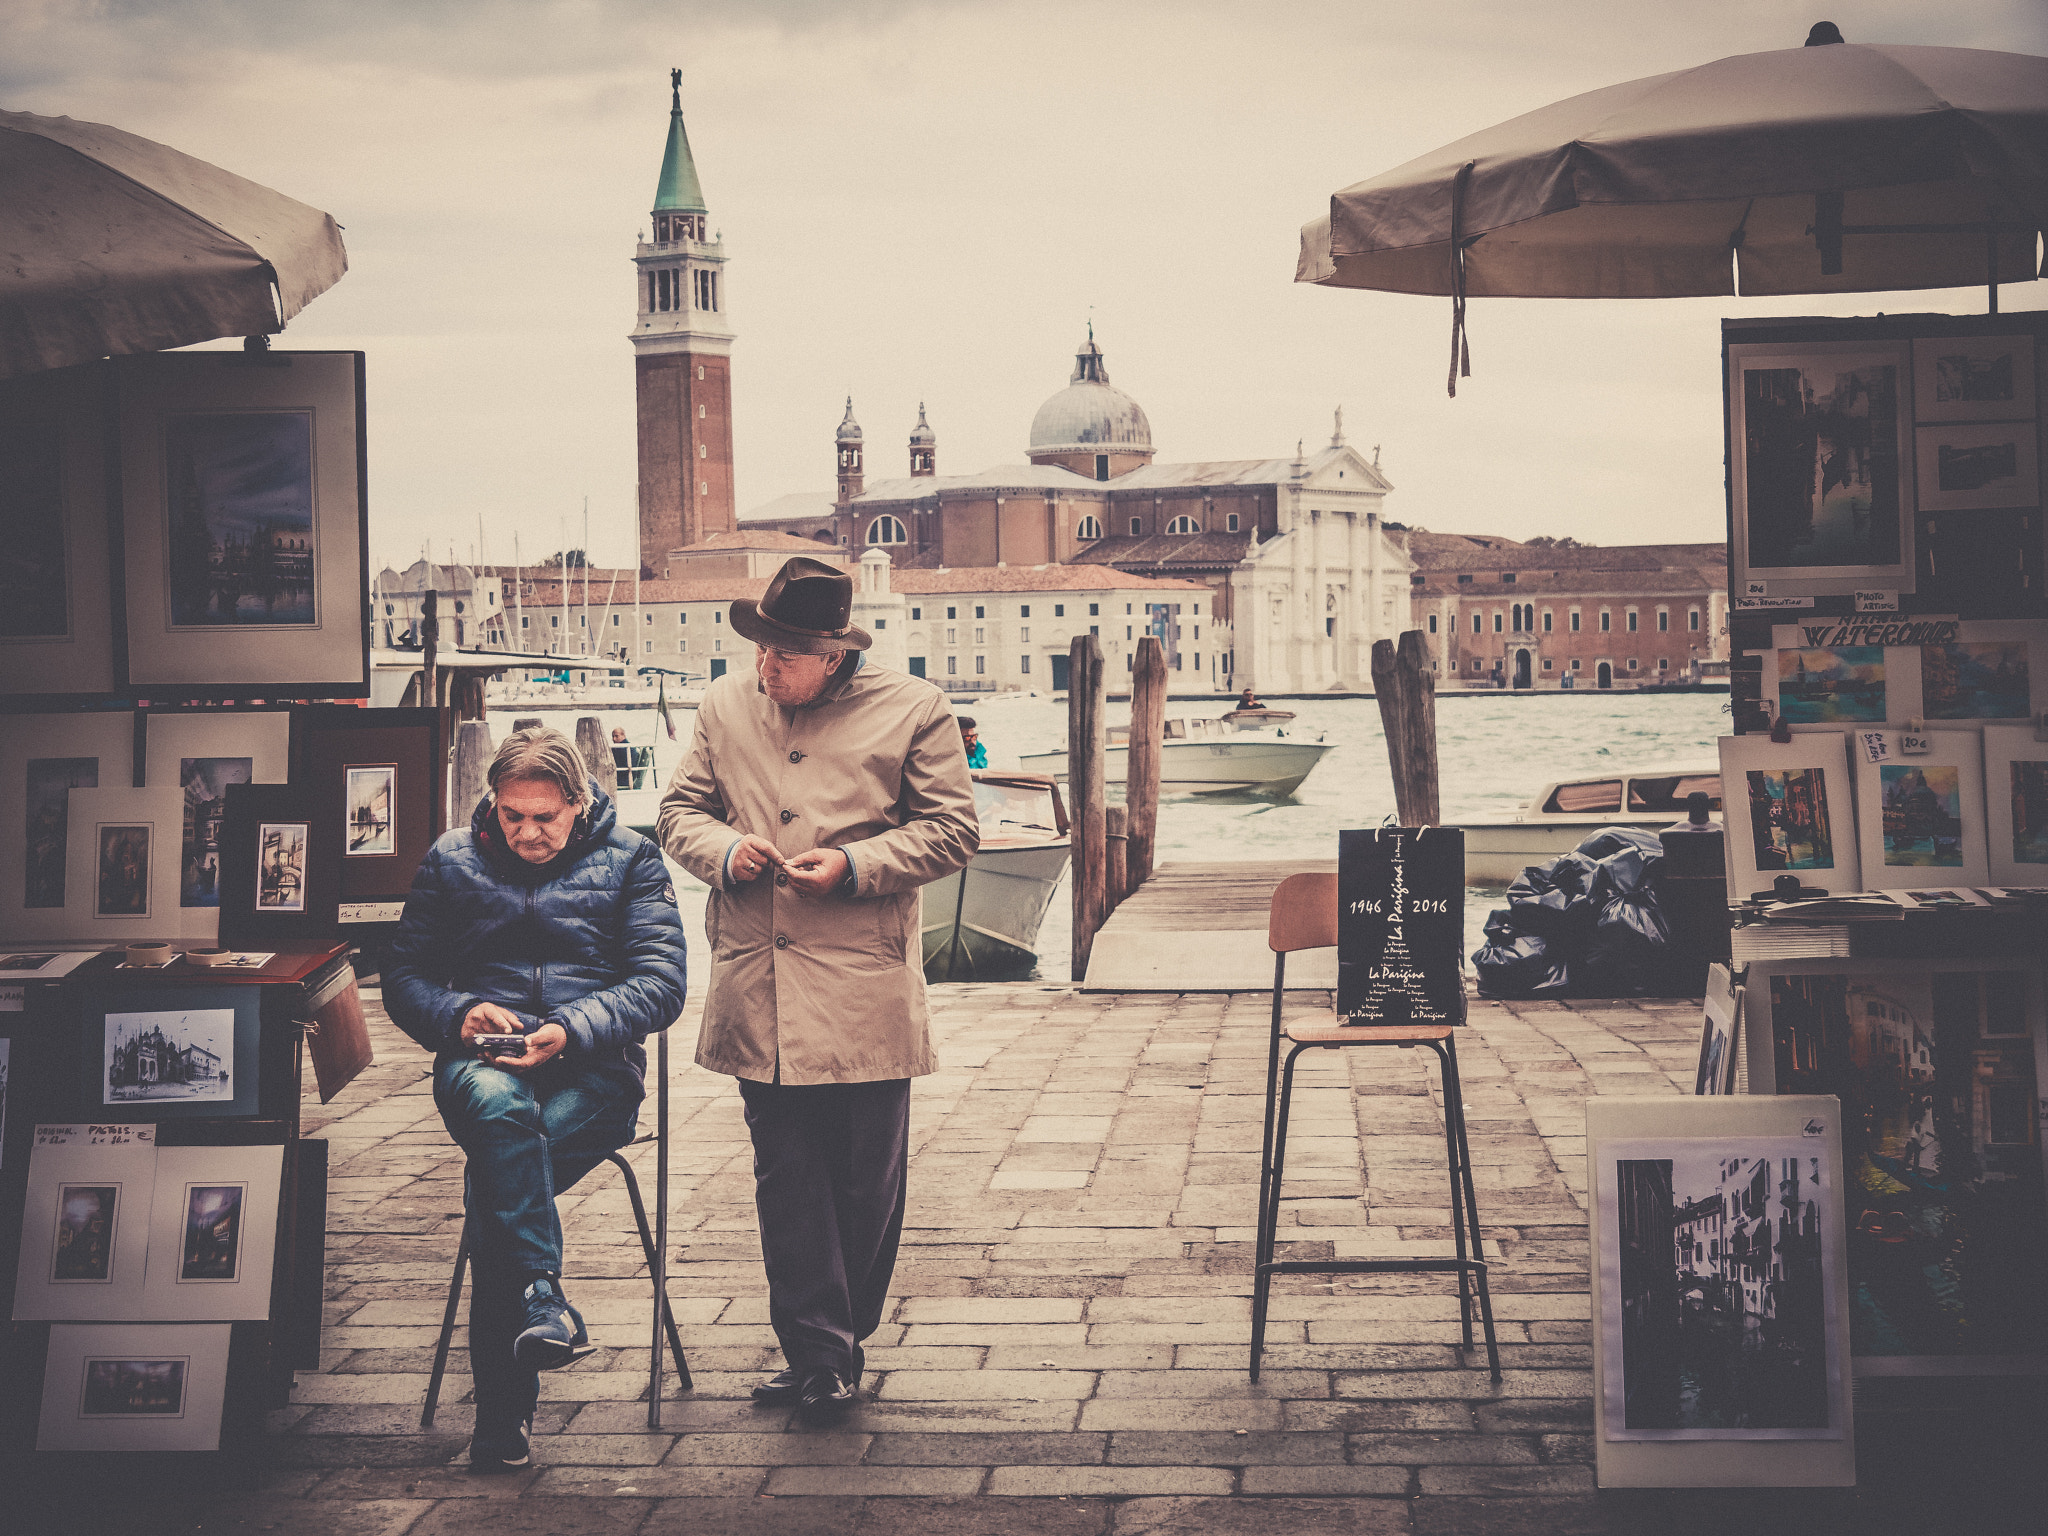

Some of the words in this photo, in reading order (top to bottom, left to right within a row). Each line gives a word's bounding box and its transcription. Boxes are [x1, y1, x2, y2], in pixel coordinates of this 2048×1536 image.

[1856, 592, 1885, 601] PHOTO
[1387, 865, 1410, 922] Parigina
[1350, 899, 1382, 915] 1946
[1412, 899, 1448, 913] 2016
[1387, 925, 1403, 941] La
[1369, 966, 1380, 979] La
[1382, 966, 1426, 983] Parigina
[1349, 1009, 1357, 1018] La
[1357, 1009, 1384, 1020] Parigina
[1411, 1010, 1418, 1018] La
[1419, 1010, 1446, 1021] Parigina
